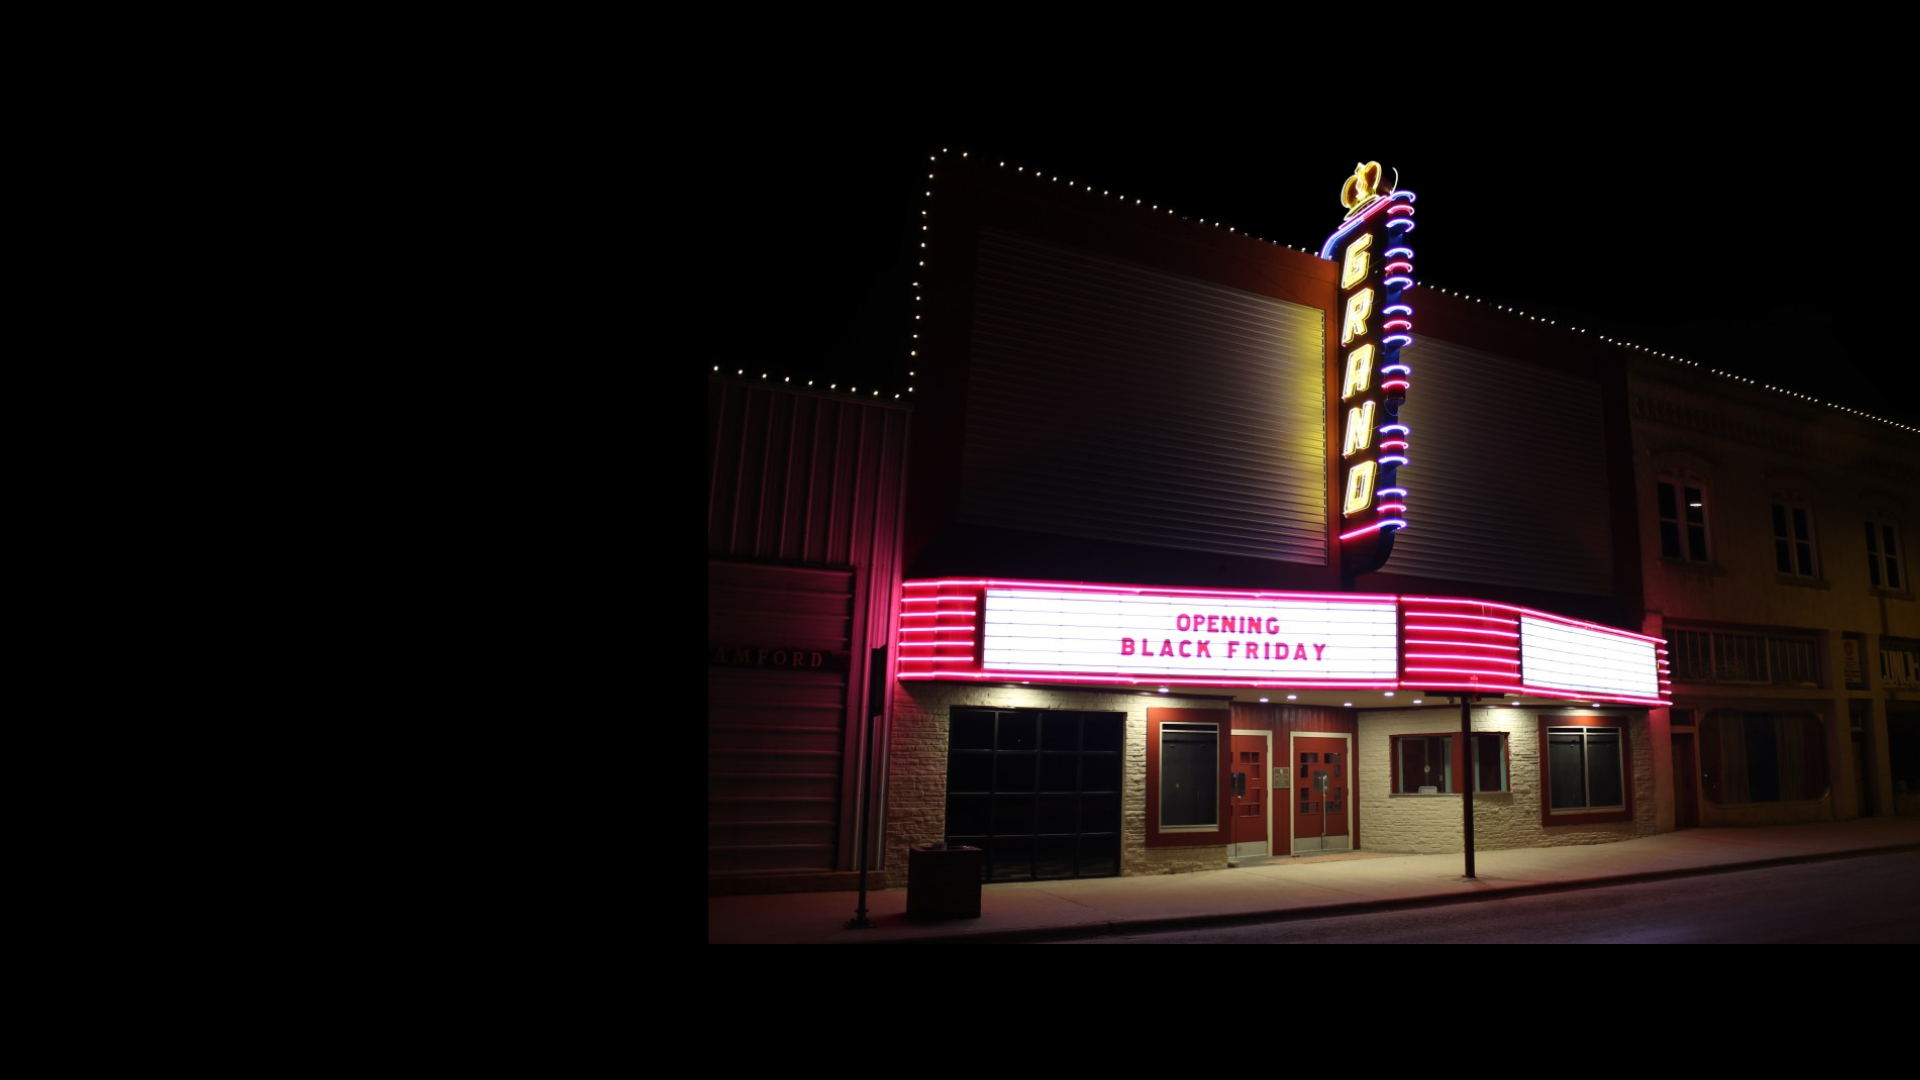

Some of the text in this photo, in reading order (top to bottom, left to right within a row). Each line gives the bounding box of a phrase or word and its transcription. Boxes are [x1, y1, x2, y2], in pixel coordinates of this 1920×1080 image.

[1342, 233, 1377, 517] GRAND
[1176, 613, 1280, 635] OPENING
[1121, 637, 1326, 661] BLACK FRIDAY
